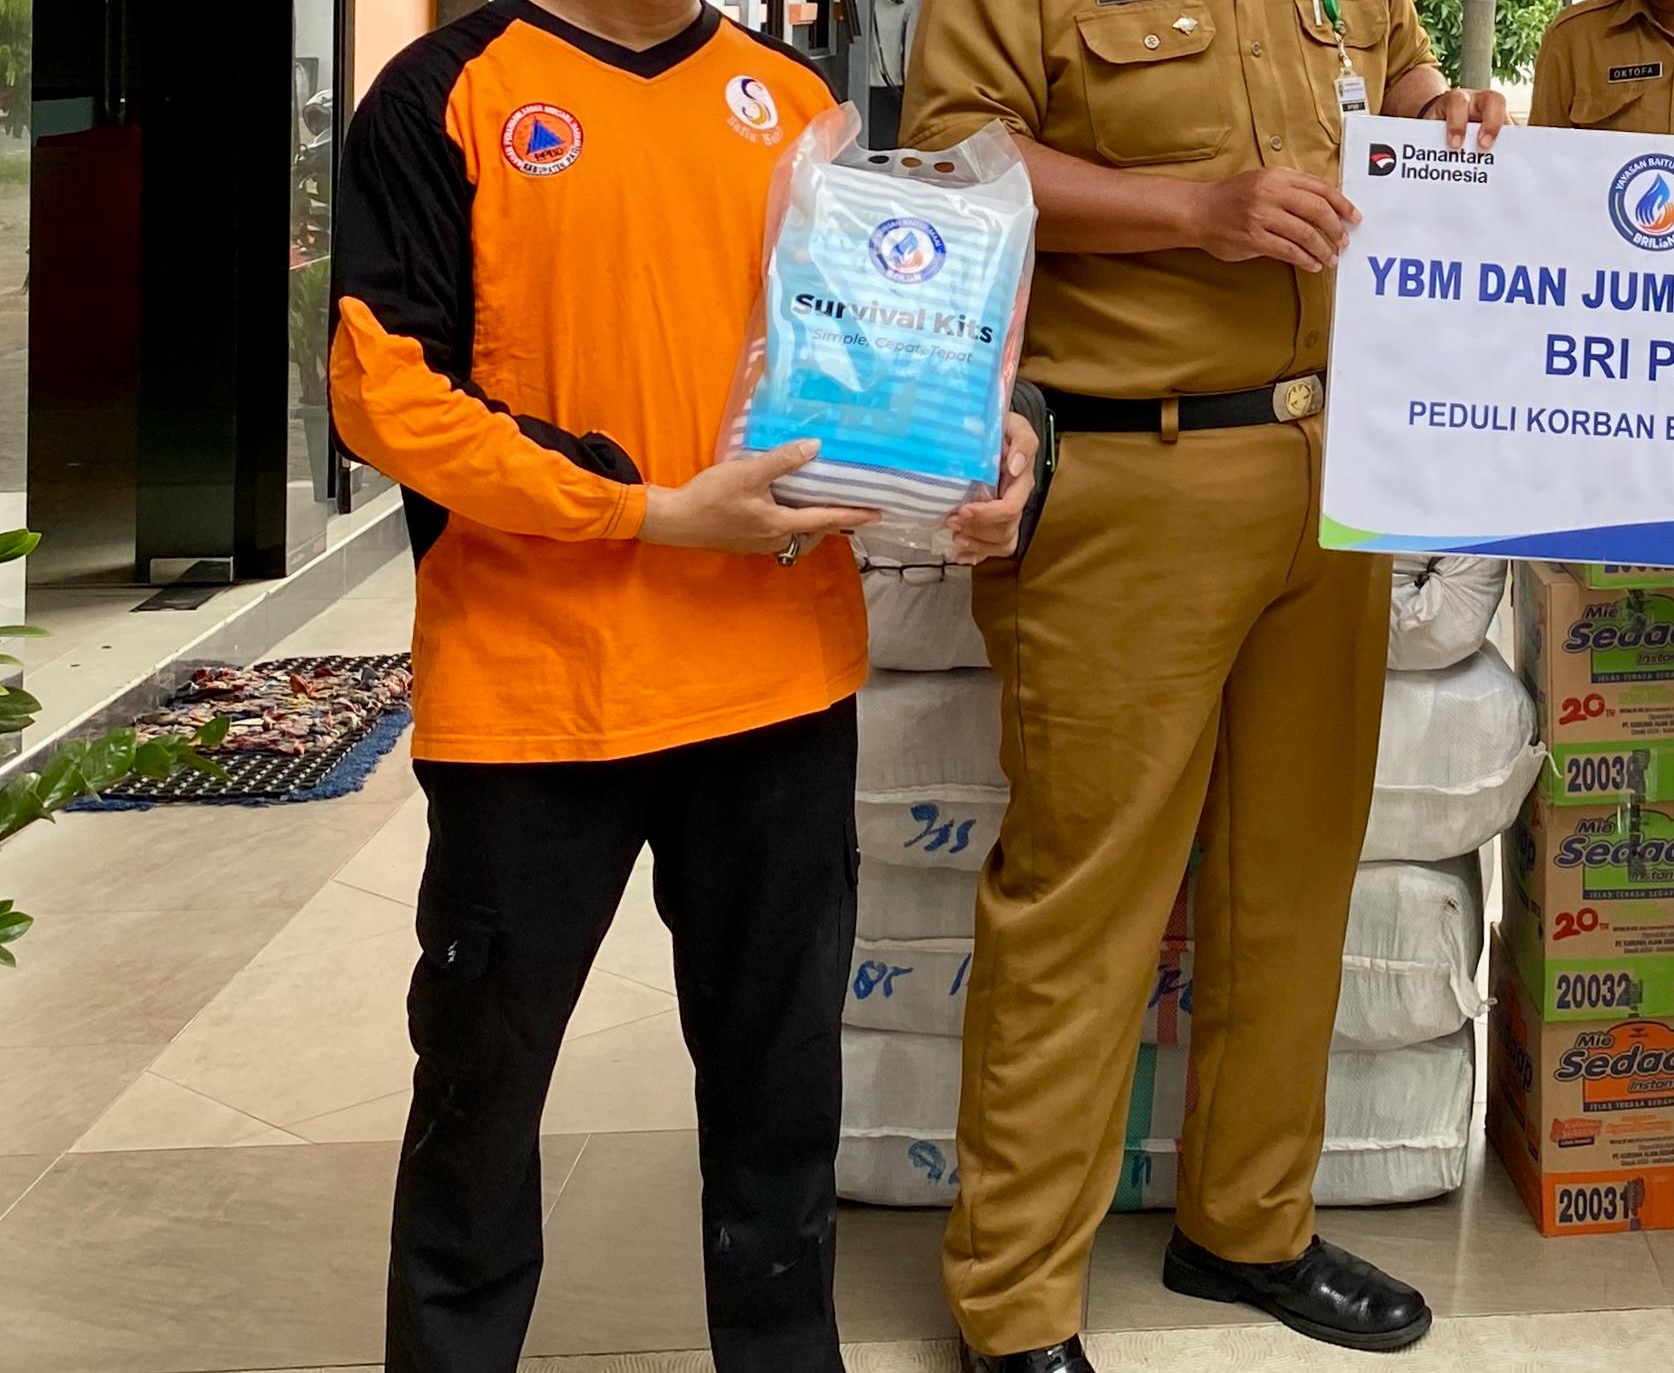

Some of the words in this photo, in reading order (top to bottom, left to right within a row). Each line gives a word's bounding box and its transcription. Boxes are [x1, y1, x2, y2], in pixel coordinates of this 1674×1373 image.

[1613, 66, 1654, 79] OKTOFA
[1402, 144, 1494, 165] Danantara
[1402, 165, 1488, 183] Indonesia
[1615, 159, 1647, 190] YAYASAN
[1367, 256, 1463, 301] YBM
[1478, 262, 1567, 307] DAN
[791, 293, 926, 330] Survival
[934, 312, 993, 344] Kits
[813, 329, 869, 347] Simple,
[875, 337, 924, 355] Cepat,
[931, 345, 973, 363] Tepat
[1545, 333, 1630, 380] BRI
[1409, 400, 1517, 431] PEDULI
[1526, 407, 1655, 440] KORBAN
[1583, 603, 1620, 620] Mie
[1577, 819, 1615, 834] Mie
[1556, 972, 1632, 1010] 20032
[1575, 1032, 1614, 1049] Mie
[1558, 1186, 1631, 1224] 20031
